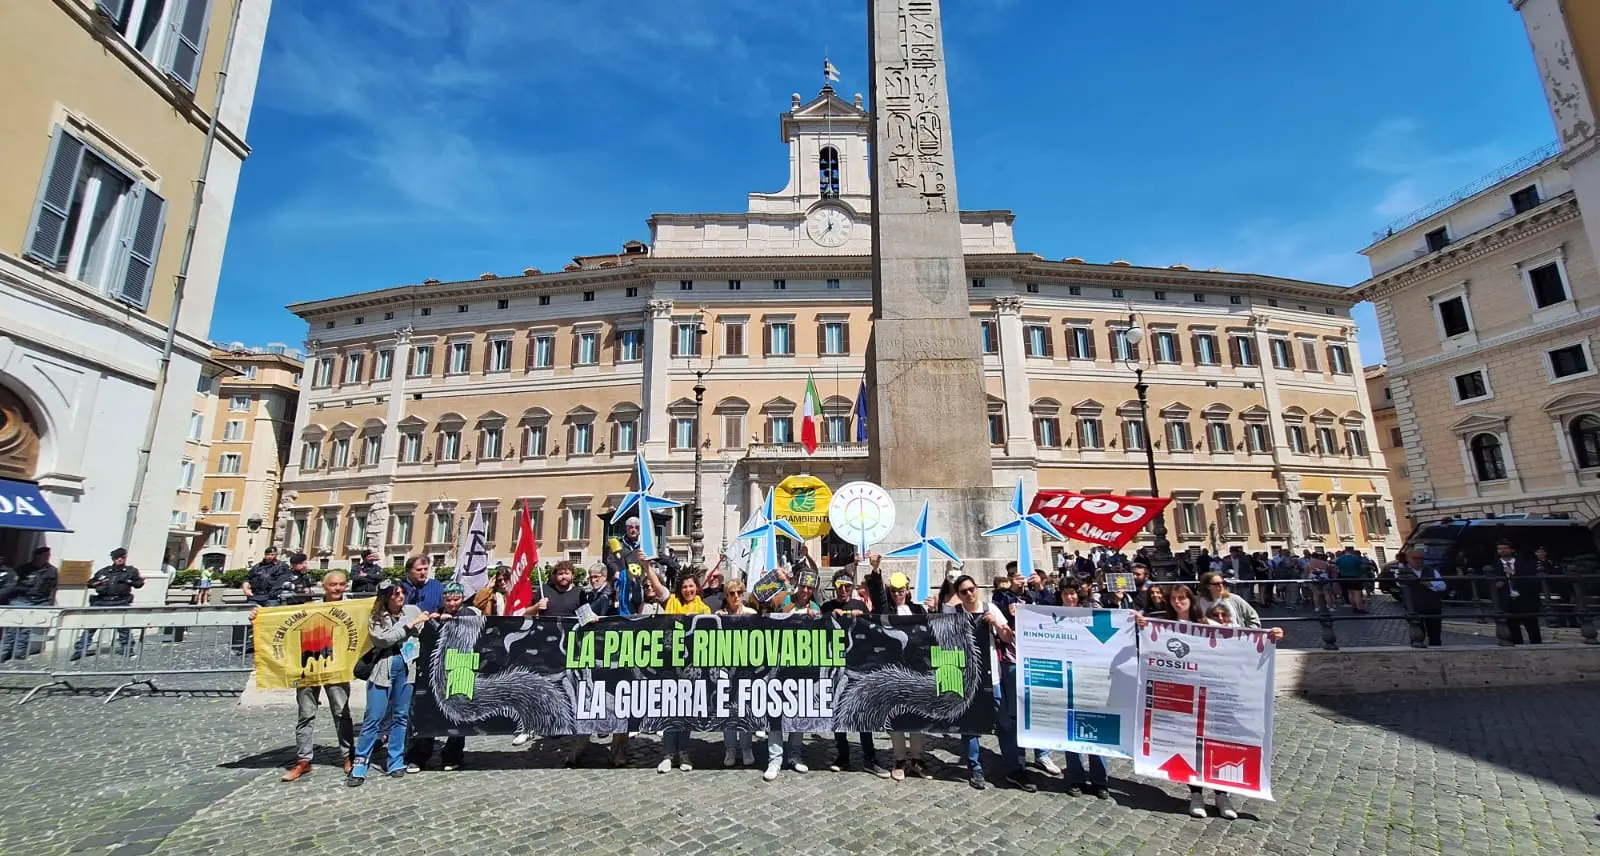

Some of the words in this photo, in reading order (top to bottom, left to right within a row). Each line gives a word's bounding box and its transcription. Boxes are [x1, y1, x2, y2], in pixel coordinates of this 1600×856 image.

[566, 631, 595, 668] LA
[603, 630, 664, 667] PACE
[672, 620, 685, 667] È
[693, 629, 847, 667] RINNOVABILE
[1023, 630, 1078, 641] RINNOVABILI
[1148, 657, 1198, 671] FOSSILI
[577, 680, 606, 720] LA
[615, 679, 709, 719] GUERRA
[717, 669, 731, 718] È
[738, 678, 833, 718] FOSSILE
